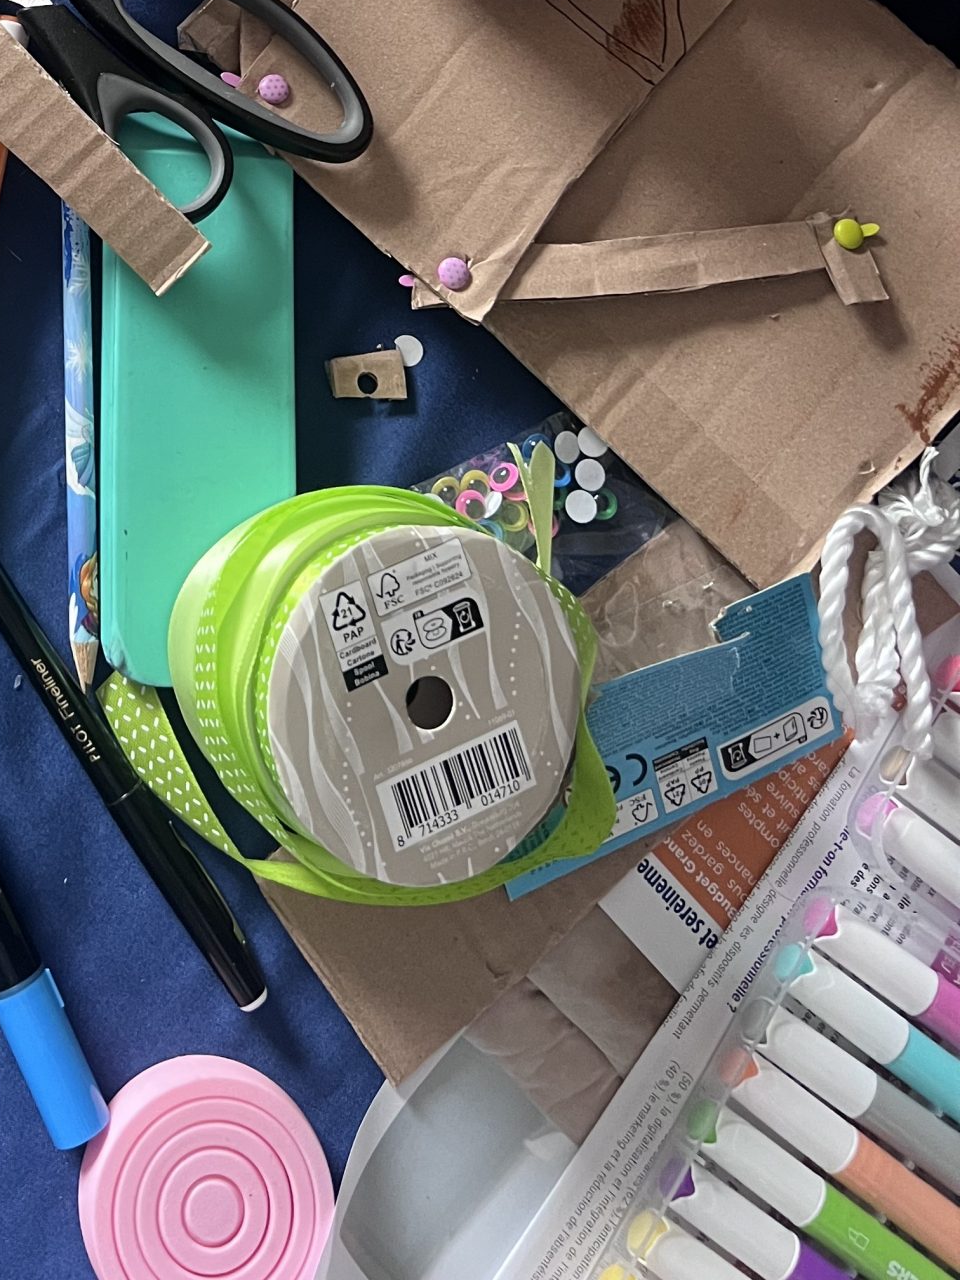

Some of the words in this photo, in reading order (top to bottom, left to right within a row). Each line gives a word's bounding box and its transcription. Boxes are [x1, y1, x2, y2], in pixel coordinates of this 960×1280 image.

[339, 606, 353, 619] 21
[383, 593, 405, 610] FSC
[342, 625, 365, 643] PAP
[338, 637, 377, 659] Cardboard
[29, 654, 76, 720] Fineliner
[69, 721, 101, 763] PILOT
[693, 765, 704, 774] PP
[846, 765, 862, 781] La
[664, 776, 680, 787] PAP
[759, 802, 777, 820] et
[762, 780, 800, 820] suivre
[817, 778, 853, 824] formation
[395, 834, 406, 848] 8
[418, 808, 460, 837] 714333
[479, 778, 521, 807] 014710
[693, 818, 714, 840] en
[678, 828, 726, 876] gardez
[770, 820, 825, 890] professionnelle
[848, 869, 867, 889] des
[631, 856, 706, 936] sereineme
[747, 886, 780, 926] désigne
[694, 927, 721, 953] et
[737, 923, 755, 942] les
[703, 938, 744, 990] dispositifs
[668, 986, 711, 1041] permettant
[723, 1000, 738, 1014] ?
[661, 1058, 682, 1080] (40
[674, 1070, 695, 1092] (50
[646, 1091, 661, 1105] le
[657, 1104, 672, 1119] la
[614, 1100, 654, 1152] marketing
[608, 1148, 623, 1162] et
[617, 1115, 665, 1179] digitalisation
[601, 1159, 616, 1173] la
[572, 1169, 610, 1218] réduction
[610, 1176, 625, 1191] et
[563, 1214, 580, 1233] de
[572, 1188, 616, 1248] l'intégration
[562, 1245, 580, 1263] de
[569, 1217, 616, 1280] l'anticipation
